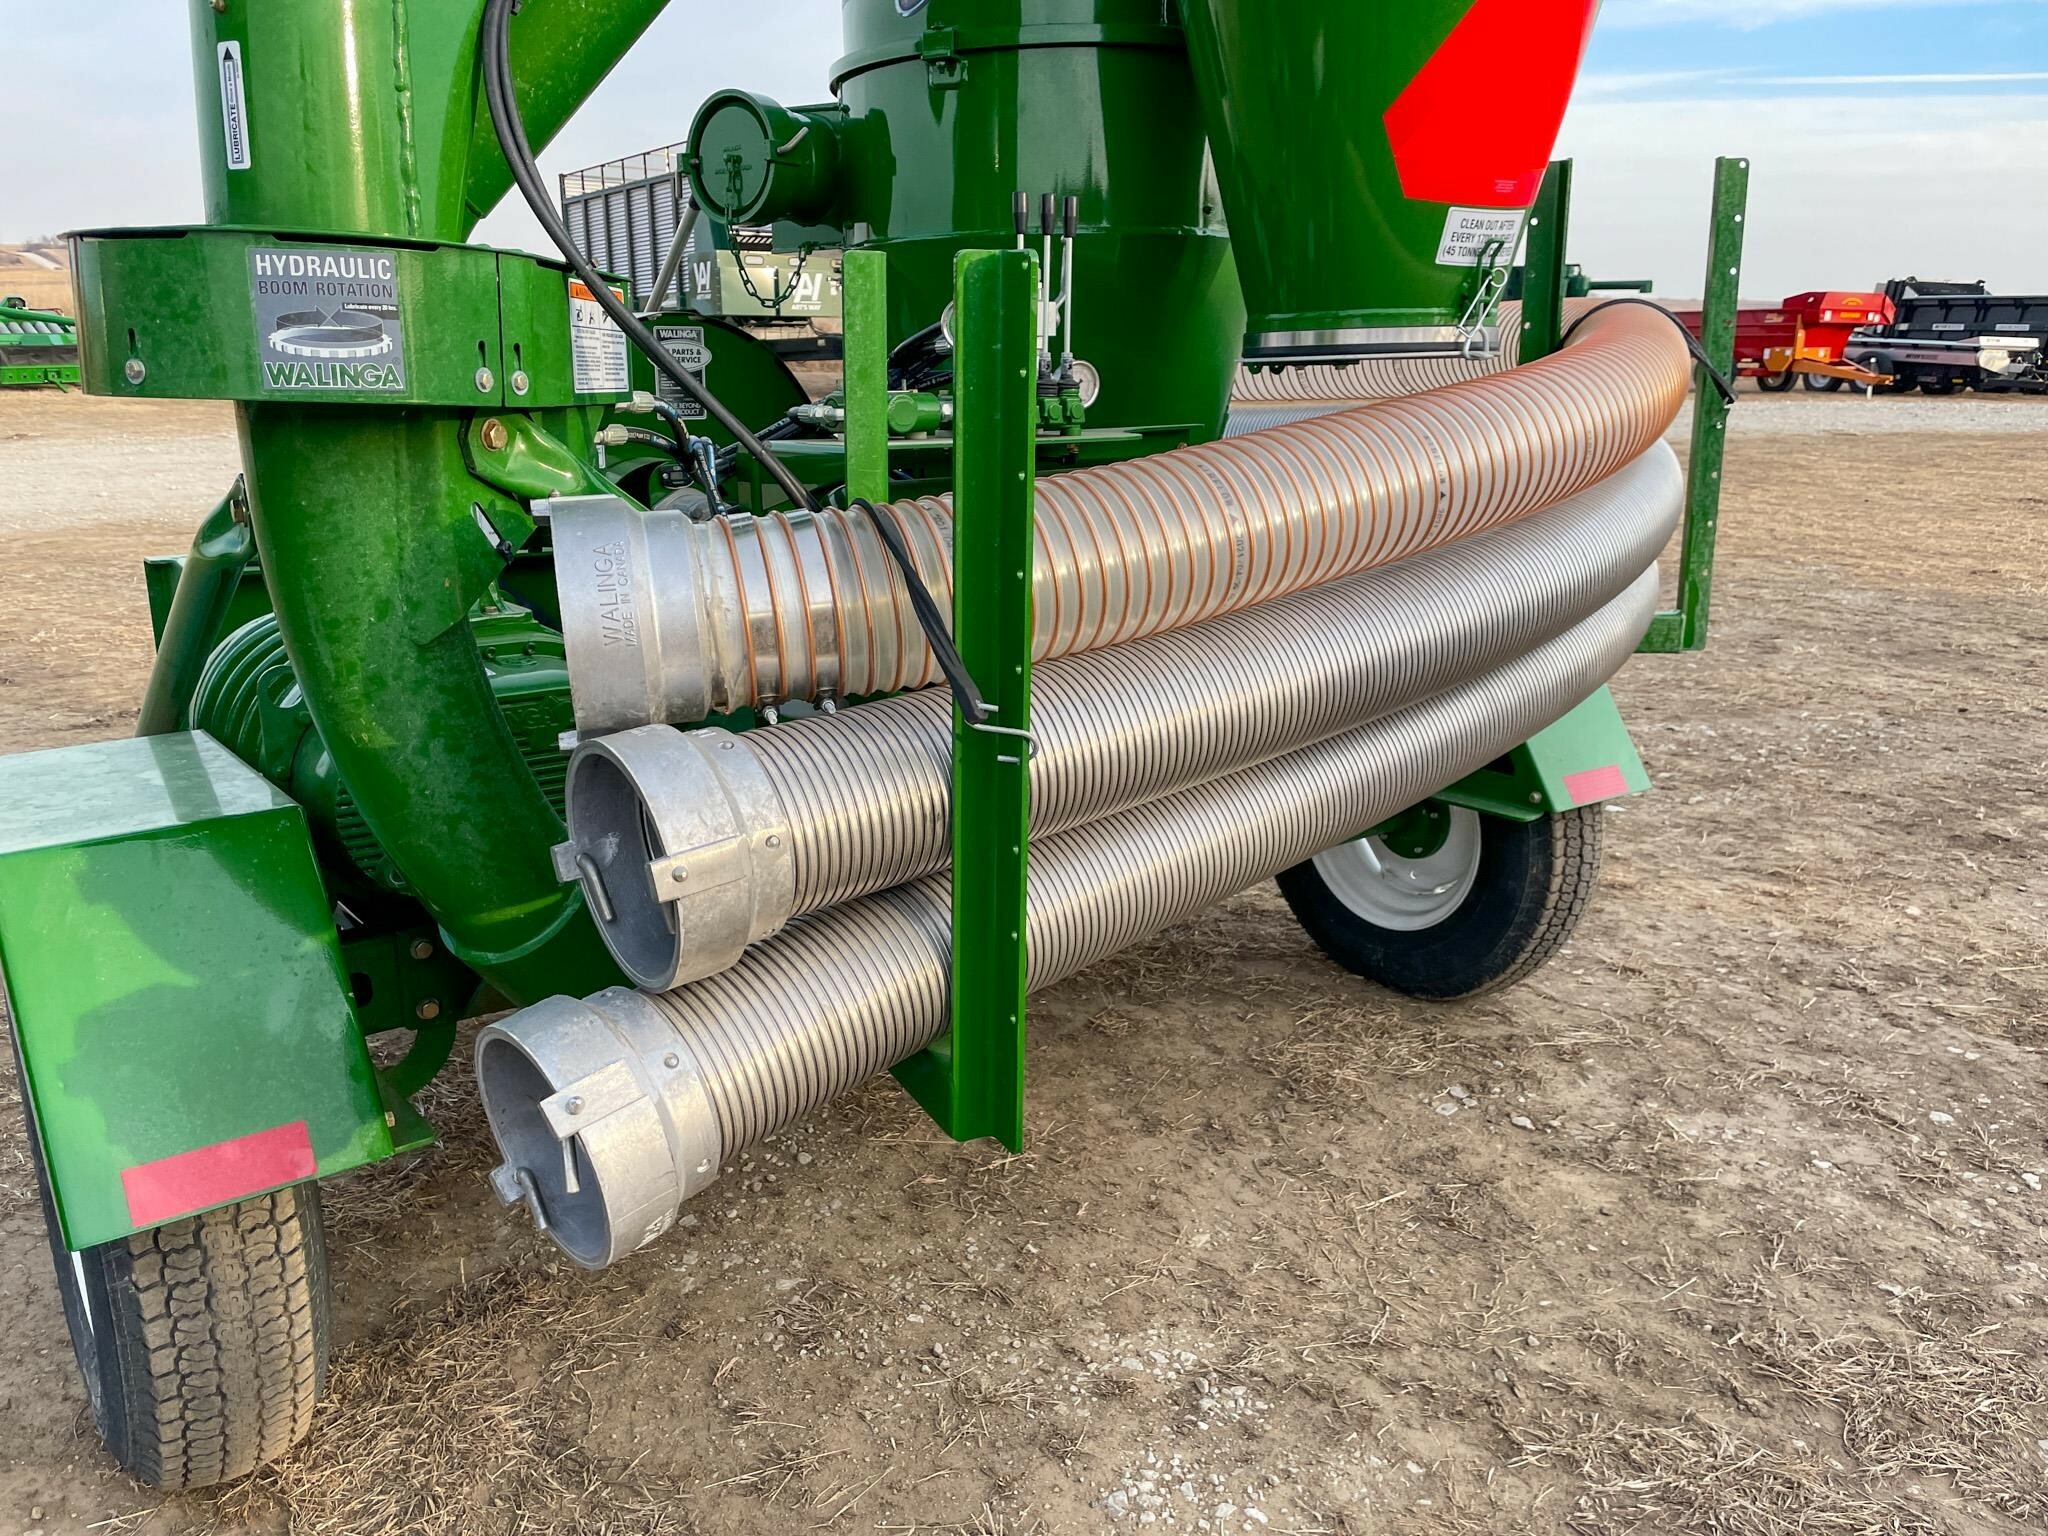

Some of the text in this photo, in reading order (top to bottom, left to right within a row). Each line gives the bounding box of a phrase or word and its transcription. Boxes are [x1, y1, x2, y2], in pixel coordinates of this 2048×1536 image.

[230, 103, 241, 161] LUBRICATE
[1460, 218, 1485, 230] CLEAN
[1485, 219, 1500, 231] OUT
[1450, 231, 1477, 243] EVERY
[1442, 245, 1457, 258] (45
[1457, 246, 1485, 257] TONNE
[255, 254, 392, 280] HYDRAULIC
[258, 280, 393, 298] BOOM ROTATION
[659, 329, 697, 339] WALINGA
[671, 348, 702, 356] PARTS &
[674, 356, 702, 364] ERVICE
[264, 361, 404, 389] WALINGA
[593, 542, 625, 647] WALINGA
[614, 539, 639, 648] MADE IN CANADA
